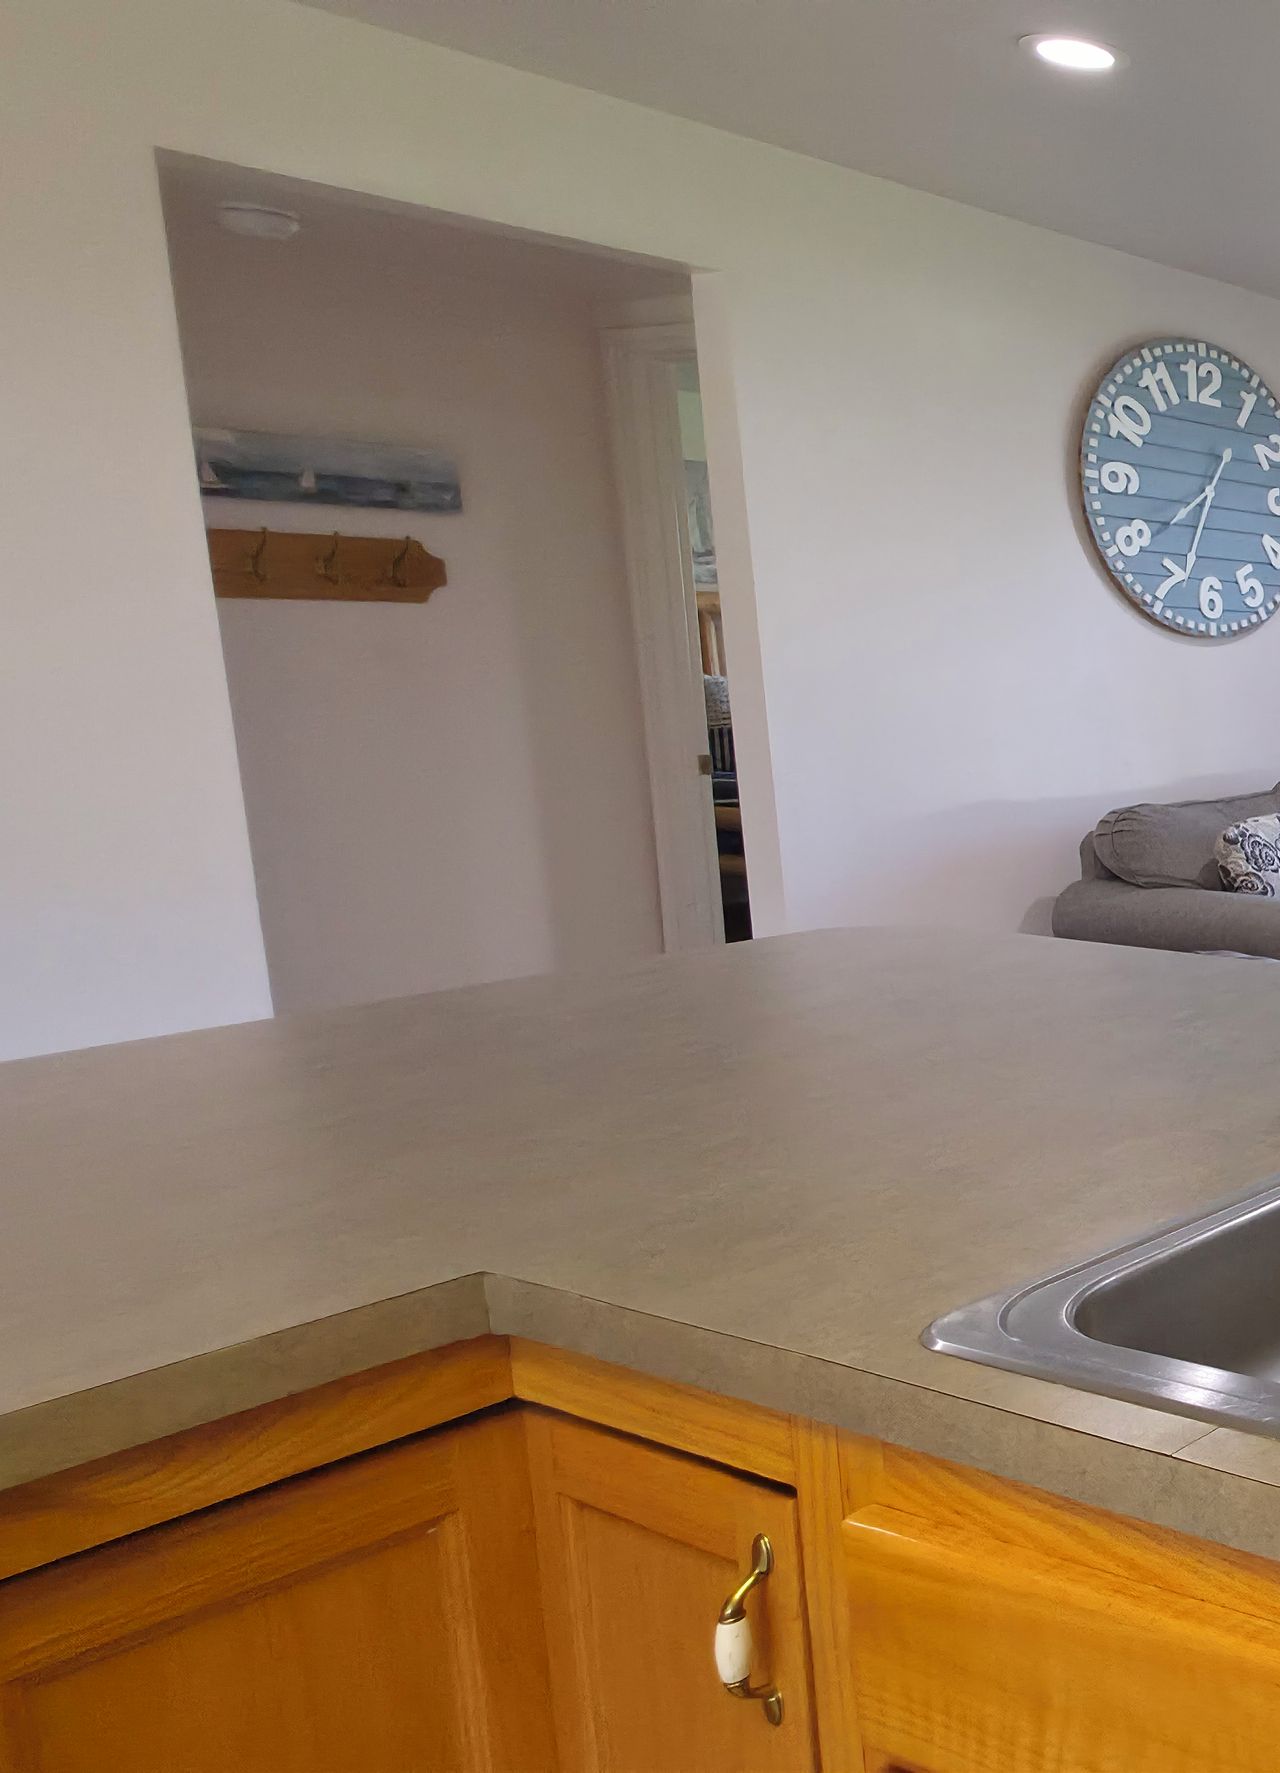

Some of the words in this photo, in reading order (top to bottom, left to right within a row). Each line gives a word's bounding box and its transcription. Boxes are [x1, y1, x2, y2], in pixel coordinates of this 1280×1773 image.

[1138, 361, 1181, 412] 11
[1180, 358, 1222, 408] 12
[1108, 395, 1151, 447] 10
[1236, 390, 1257, 428] 1
[1100, 461, 1140, 495] 9
[1115, 519, 1151, 557] 8
[1155, 557, 1187, 600] 7
[1199, 576, 1223, 619] 6
[1235, 563, 1265, 608] 5
